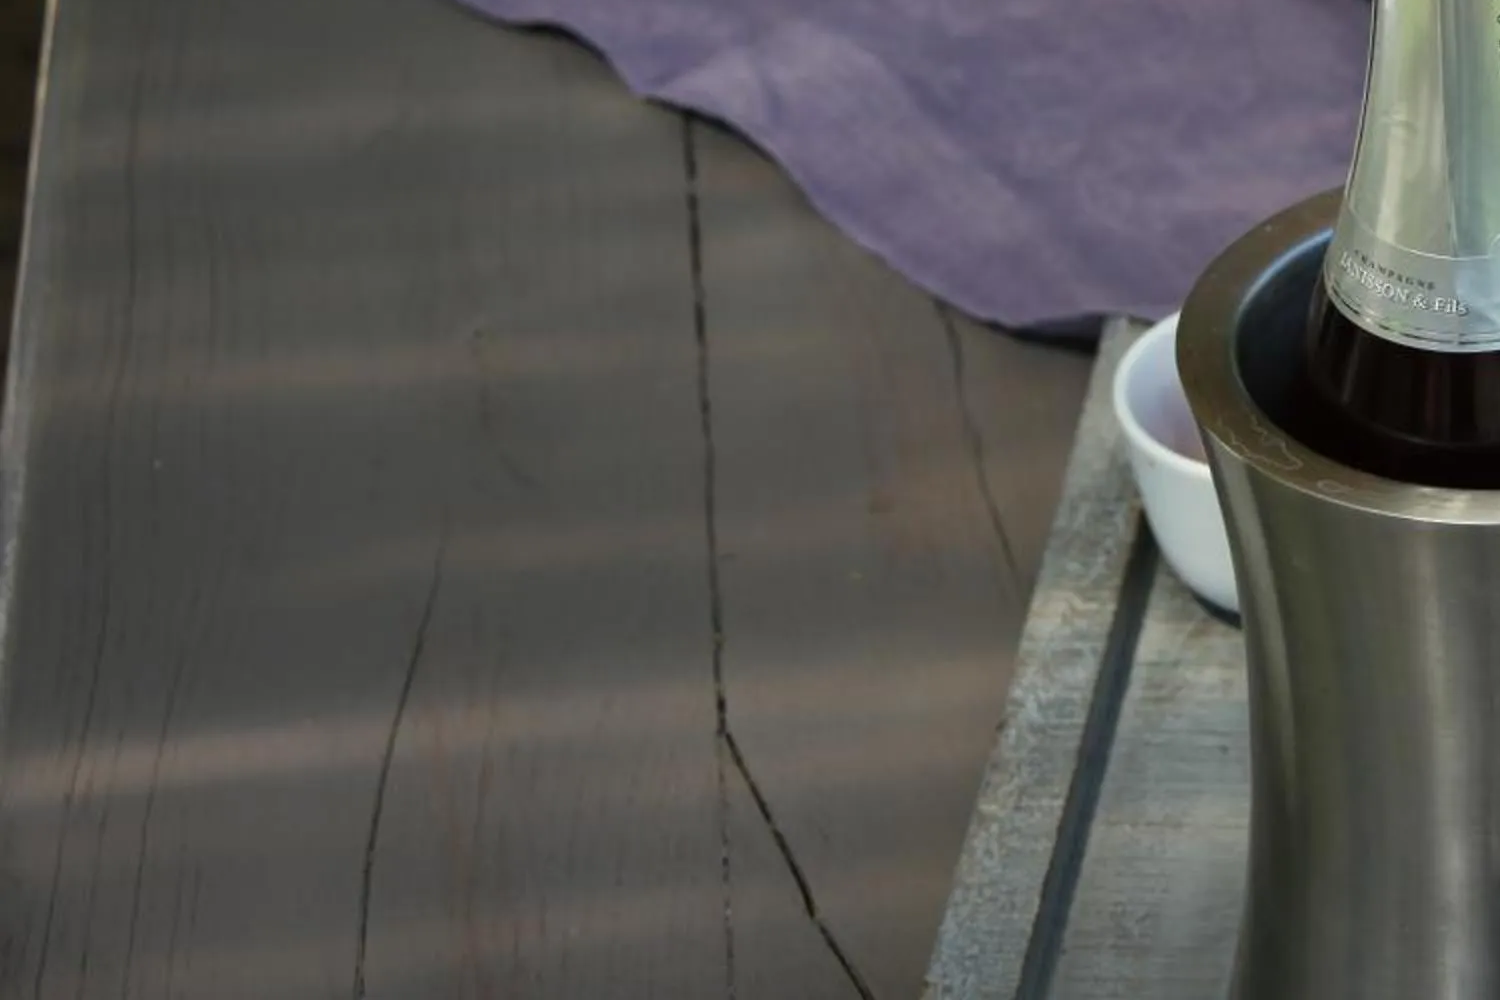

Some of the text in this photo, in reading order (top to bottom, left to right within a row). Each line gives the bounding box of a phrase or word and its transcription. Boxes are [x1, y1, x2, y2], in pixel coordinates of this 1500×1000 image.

[1339, 250, 1471, 317] JANISSON & Fils
